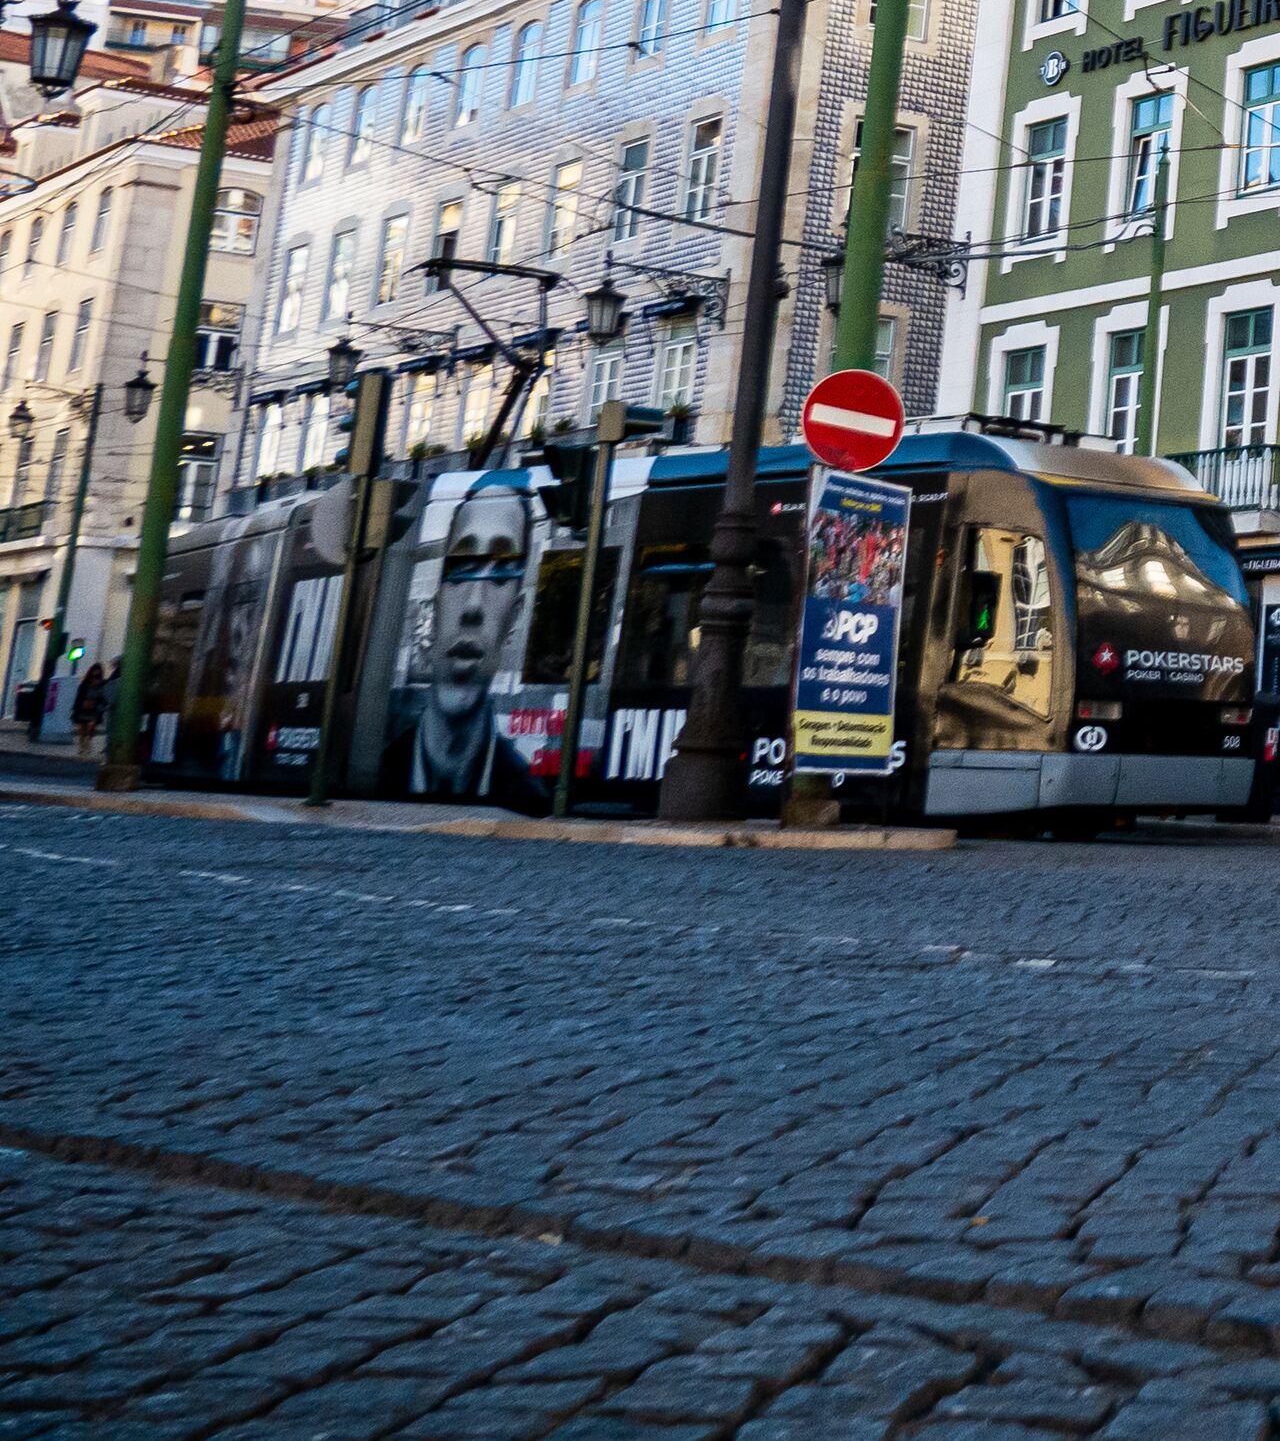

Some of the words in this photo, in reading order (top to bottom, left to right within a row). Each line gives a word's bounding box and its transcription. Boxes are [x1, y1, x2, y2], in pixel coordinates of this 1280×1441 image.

[1082, 36, 1143, 73] HOTEL
[1126, 649, 1244, 673] POKERSTARS
[1126, 669, 1161, 680] POKER
[1169, 672, 1205, 683] CASINO
